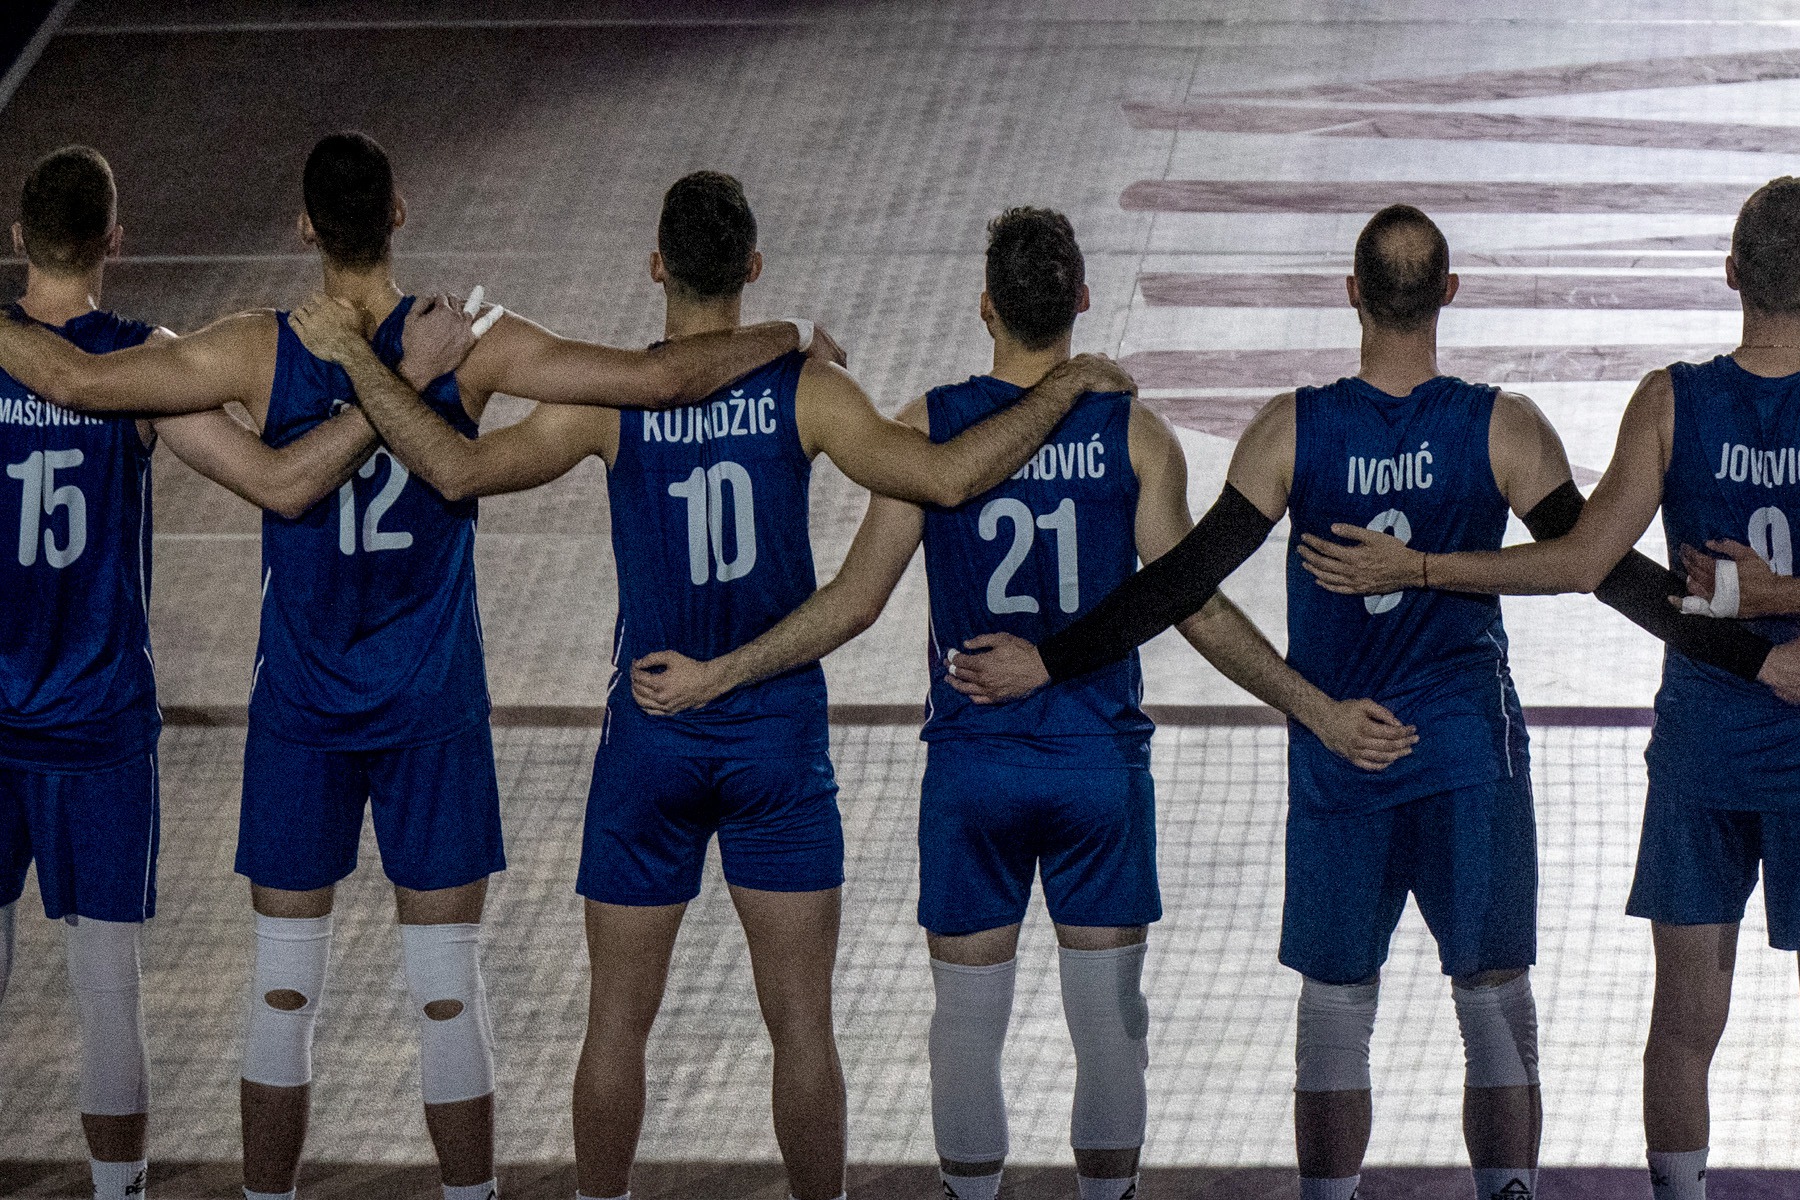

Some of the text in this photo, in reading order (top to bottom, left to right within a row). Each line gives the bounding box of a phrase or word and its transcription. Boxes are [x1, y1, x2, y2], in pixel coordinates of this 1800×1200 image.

[6, 448, 87, 569] 15
[339, 446, 414, 556] 12
[668, 461, 757, 586] 10
[978, 497, 1080, 615] 21
